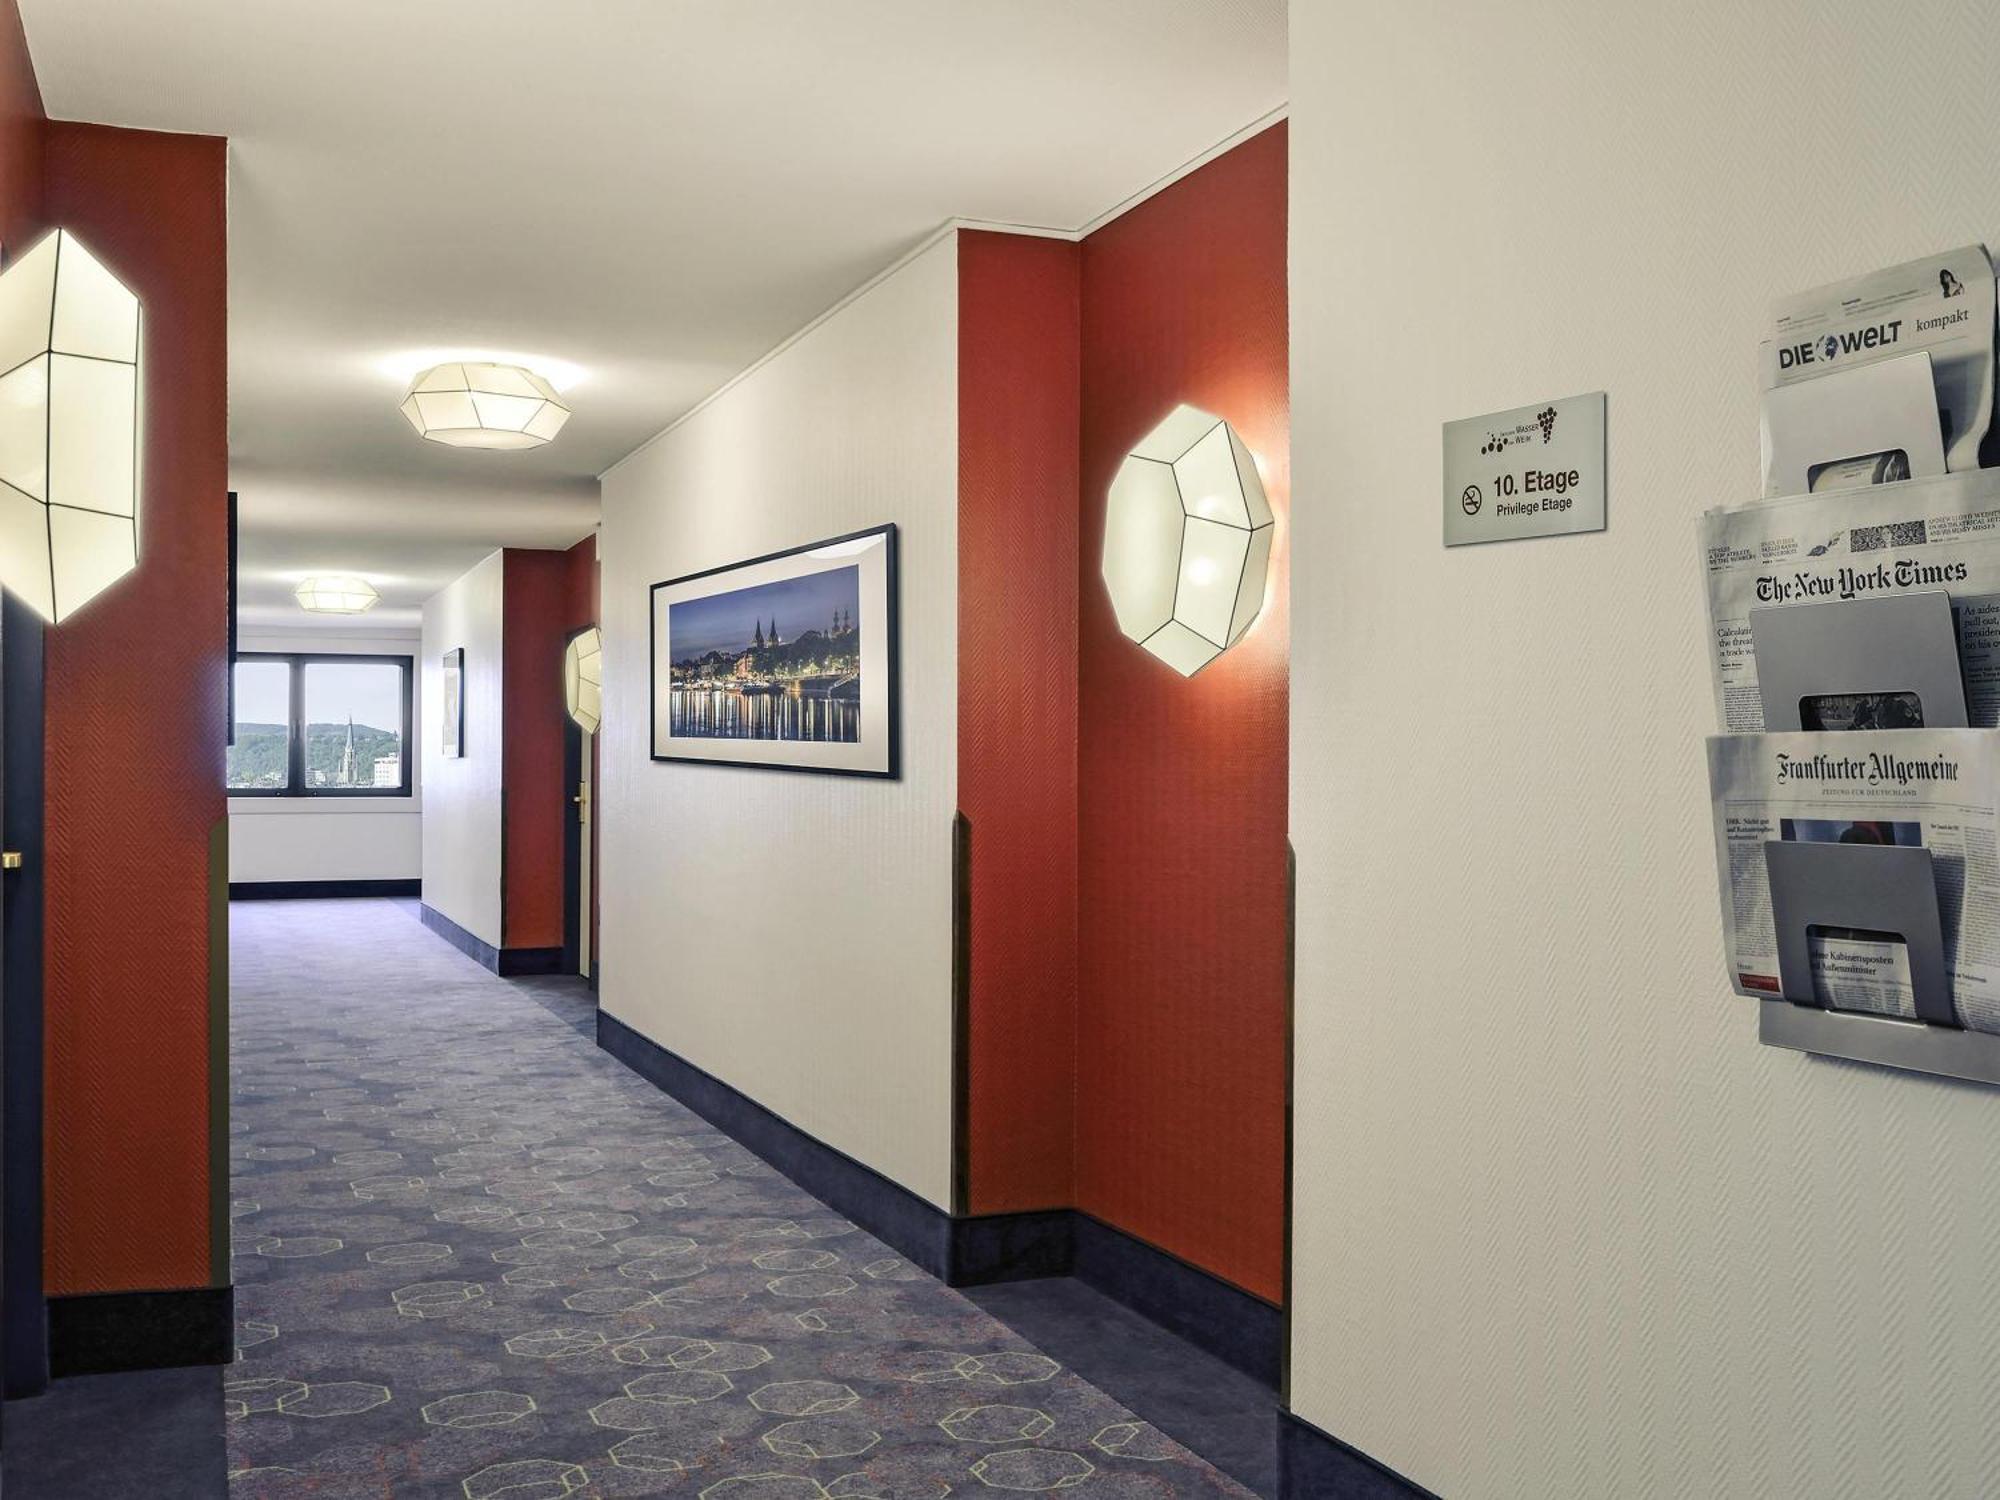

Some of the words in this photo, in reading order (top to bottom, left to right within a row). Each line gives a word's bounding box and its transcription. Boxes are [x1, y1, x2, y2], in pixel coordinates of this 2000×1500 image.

[1779, 342, 1815, 369] DIE
[1916, 309, 1969, 332] kompakt
[1494, 474, 1518, 496] 10.
[1525, 469, 1580, 494] Etage
[1496, 502, 1539, 516] Privilege
[1542, 498, 1573, 512] Etage
[1756, 577, 1791, 603] The
[1795, 573, 1834, 599] New
[1838, 564, 1891, 599] York
[1894, 559, 1968, 587] Times
[1776, 753, 1866, 785] Frankfurter
[1868, 752, 1958, 786] Allgemeine
